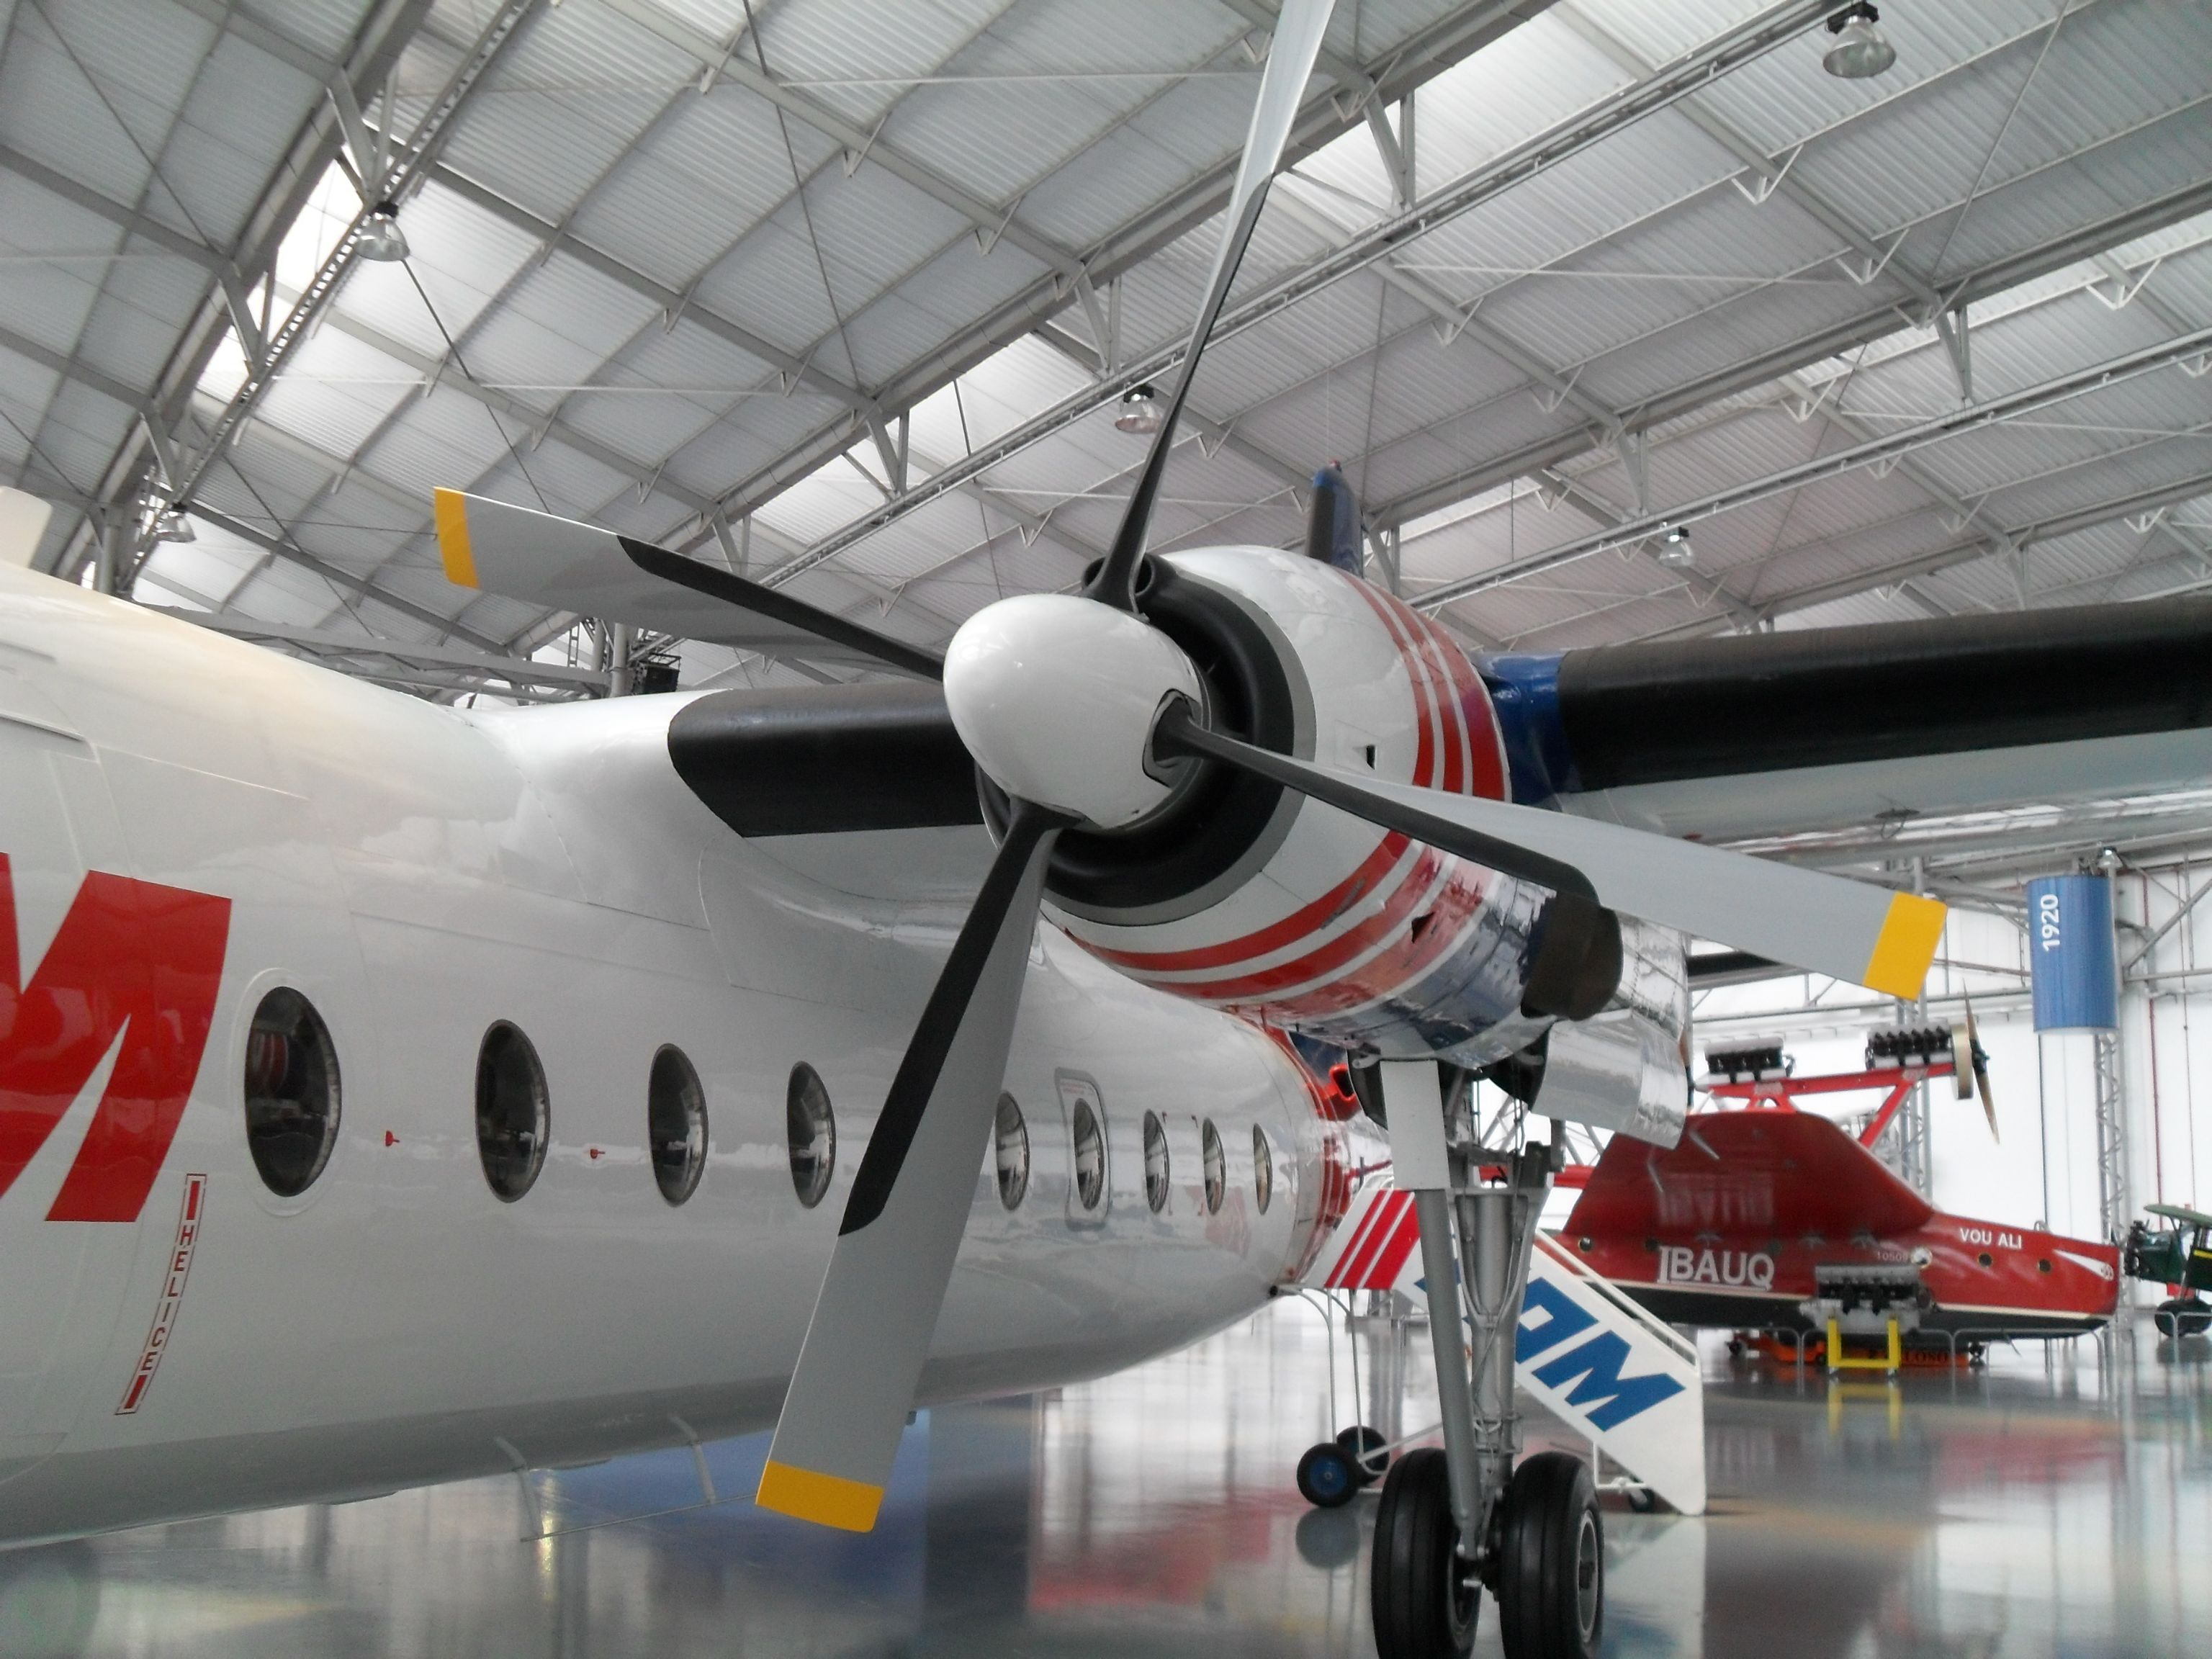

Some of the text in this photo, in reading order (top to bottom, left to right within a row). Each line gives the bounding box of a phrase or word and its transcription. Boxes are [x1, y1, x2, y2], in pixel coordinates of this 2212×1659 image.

[2041, 894, 2060, 951] 1920
[1960, 1227, 2023, 1249] VOU ALI
[140, 1225, 196, 1371] HELICE
